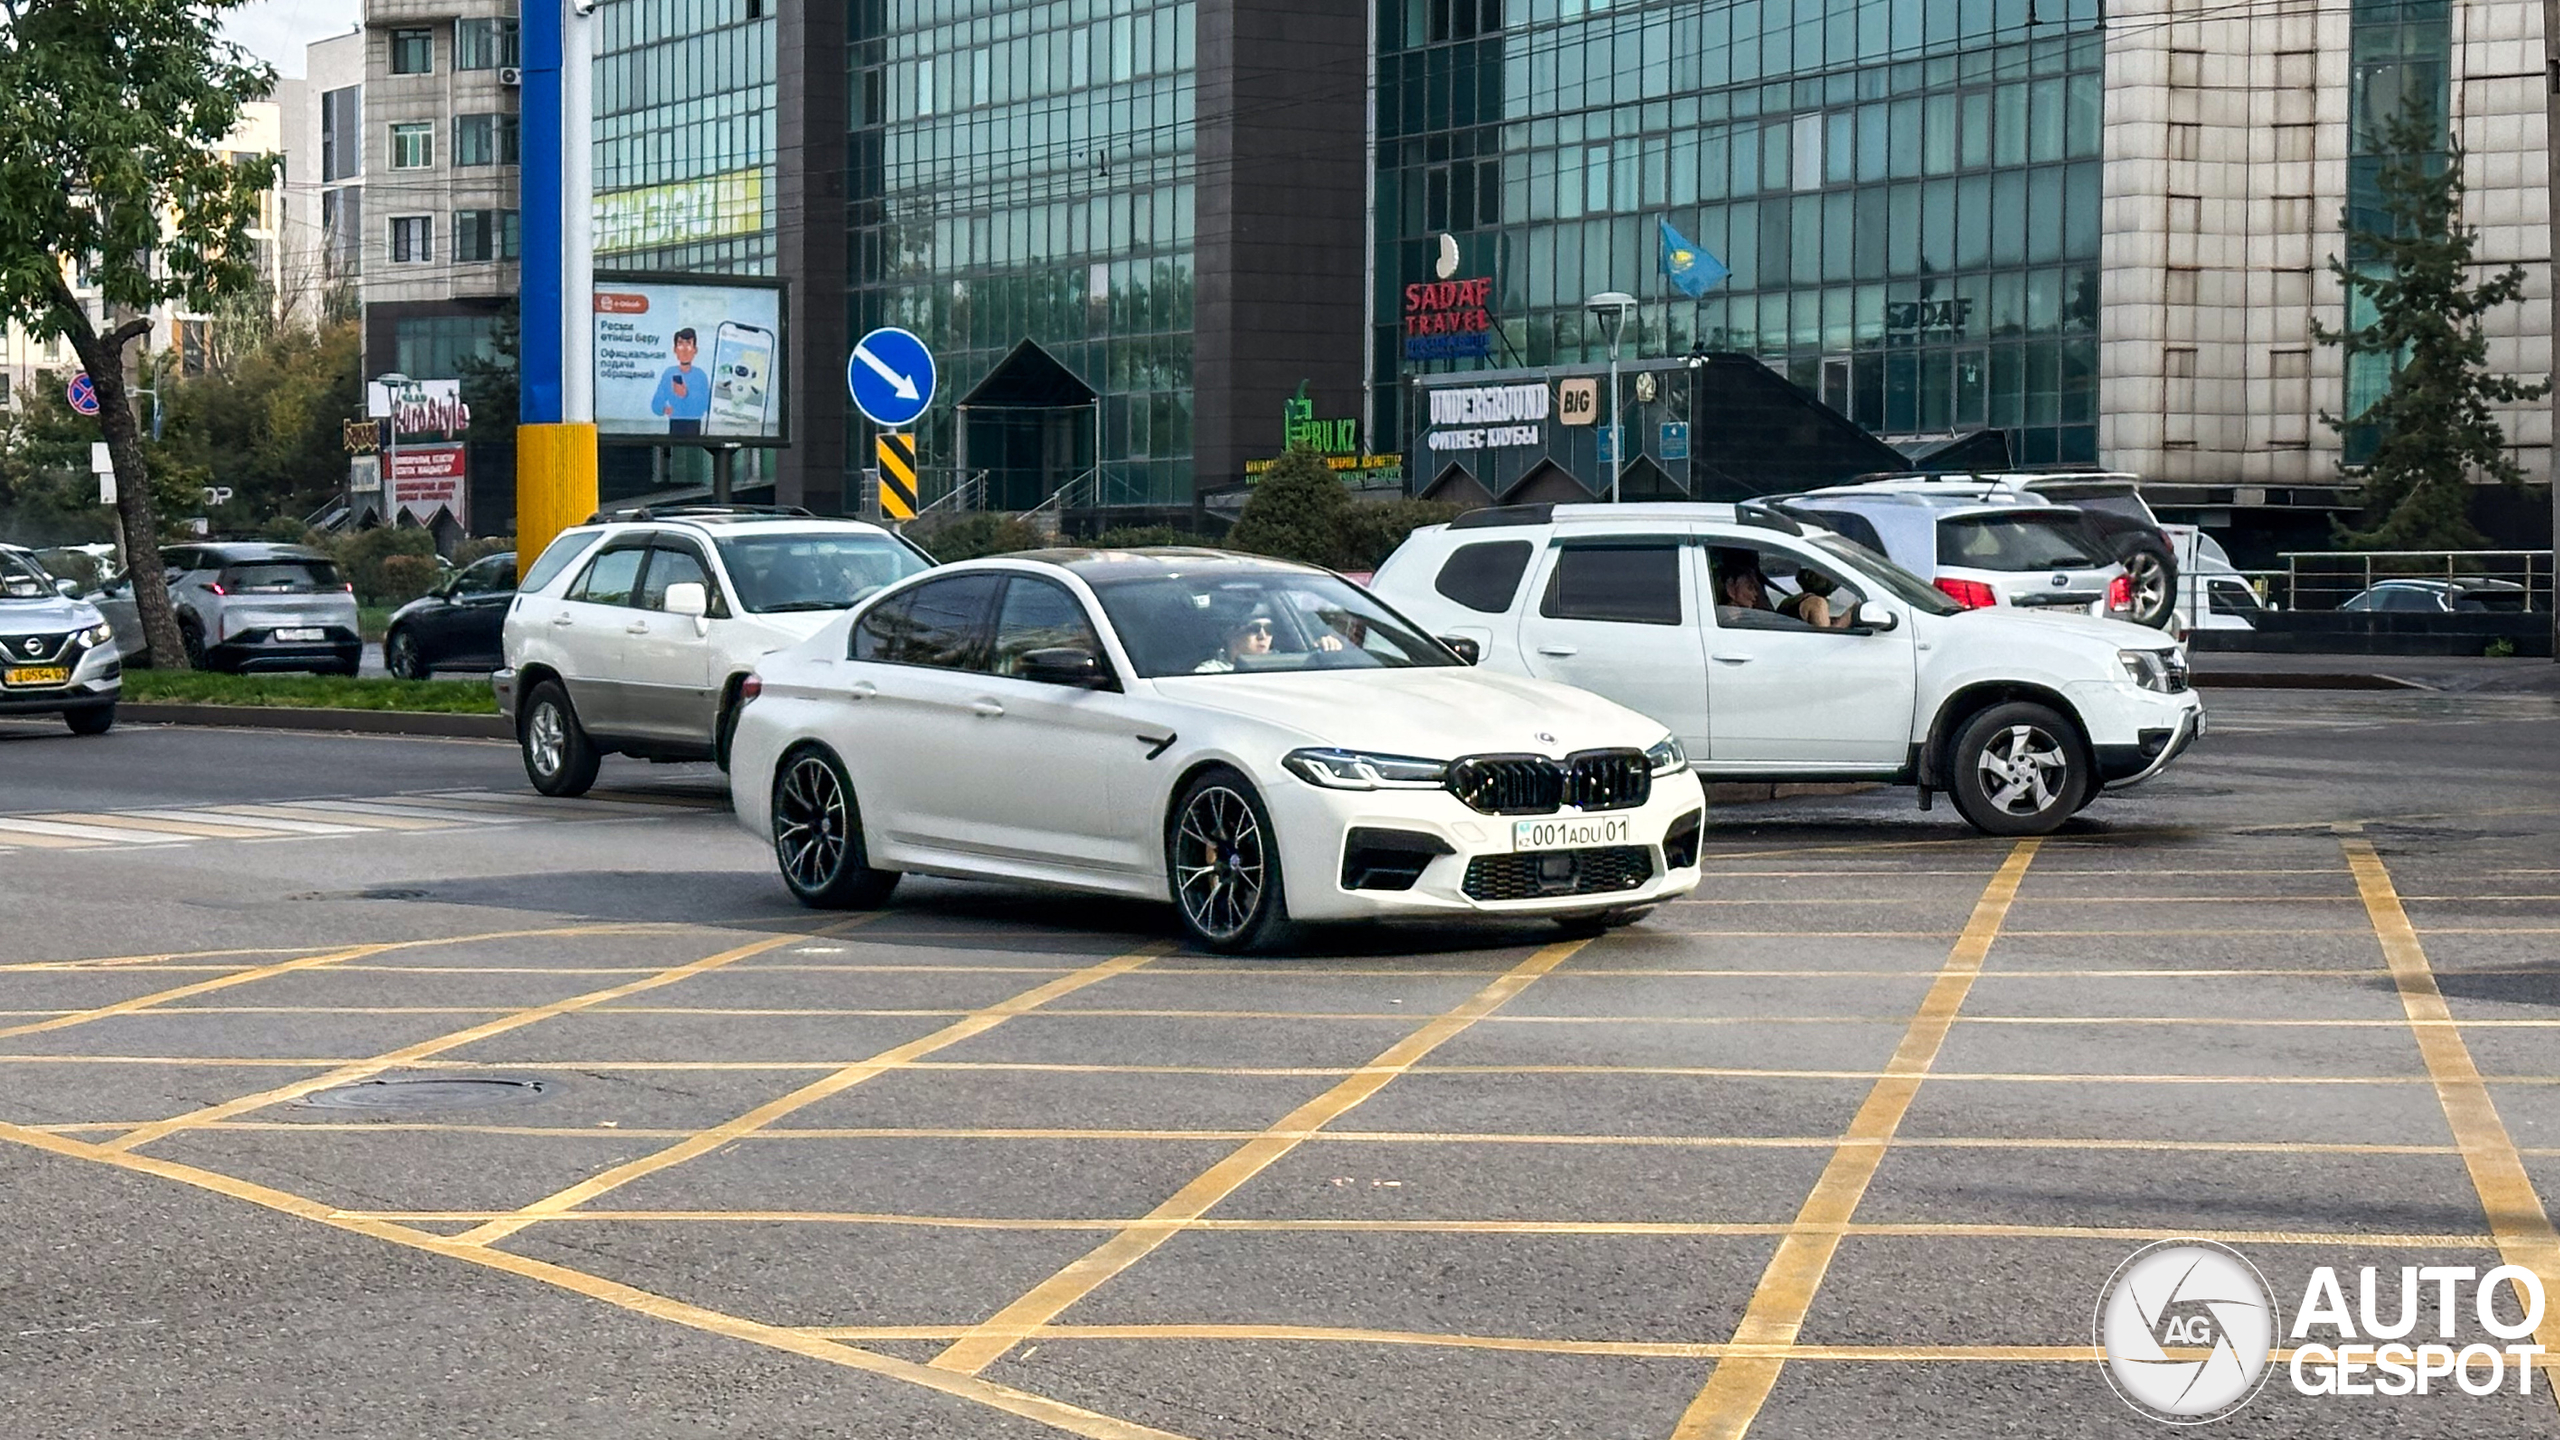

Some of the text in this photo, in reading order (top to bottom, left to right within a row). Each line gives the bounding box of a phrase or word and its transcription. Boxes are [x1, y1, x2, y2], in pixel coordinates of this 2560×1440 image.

[1405, 278, 1492, 311] SADAF
[1405, 310, 1490, 335] TRAVEL
[635, 333, 660, 346] беру
[600, 361, 635, 369] подача
[601, 349, 666, 360] Официальная
[1429, 383, 1549, 425] UNDERGROUND
[1564, 389, 1591, 414] BIG
[1428, 425, 1539, 451] ФИТНЕС КЛУБЫ
[1519, 837, 1530, 847] KZ
[1606, 820, 1628, 842] 01
